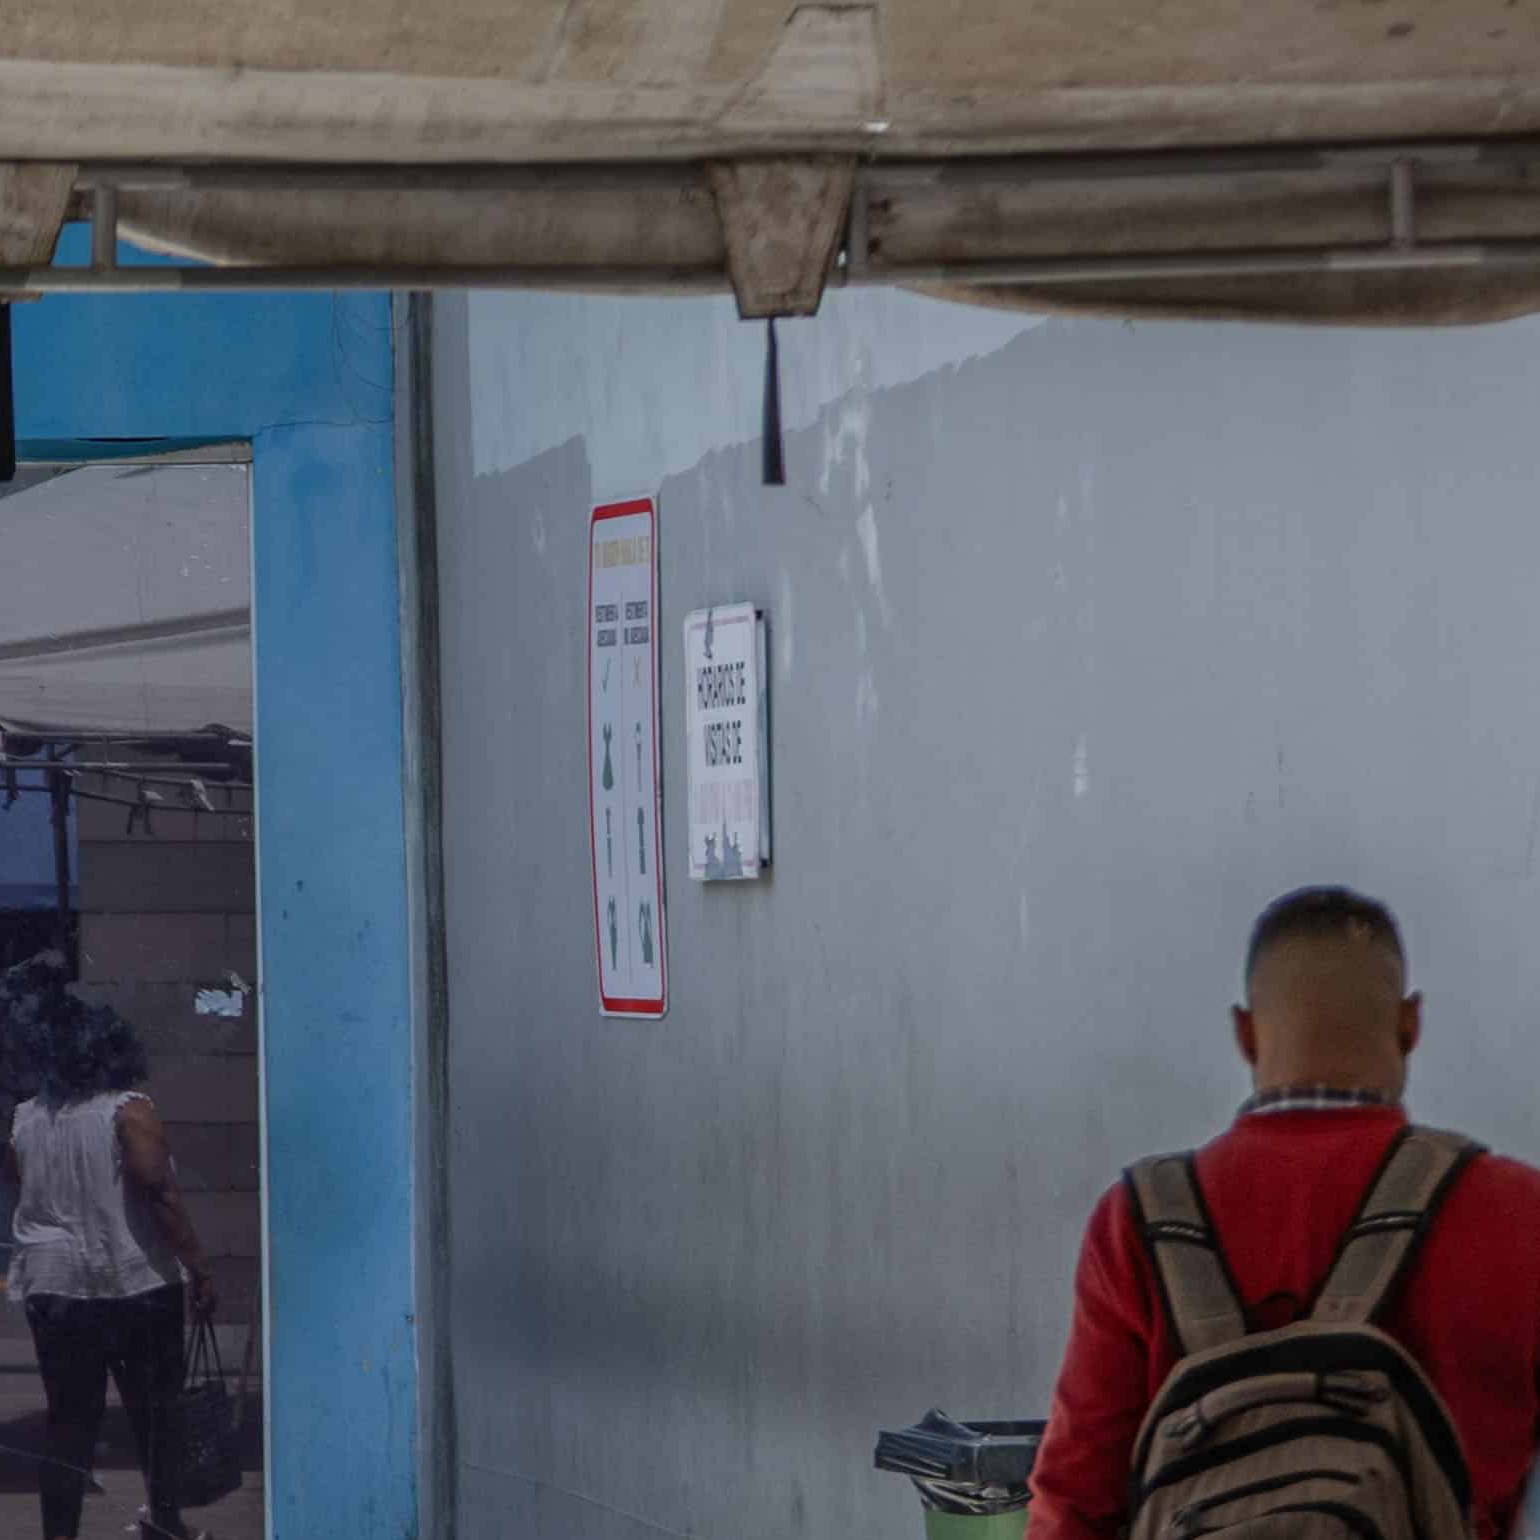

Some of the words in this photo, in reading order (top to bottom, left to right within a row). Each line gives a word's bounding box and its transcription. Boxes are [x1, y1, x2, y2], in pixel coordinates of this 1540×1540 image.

[697, 664, 735, 711] HORARIOS
[735, 661, 746, 705] DE
[703, 722, 731, 767] VISITAS
[732, 720, 742, 764] DE
